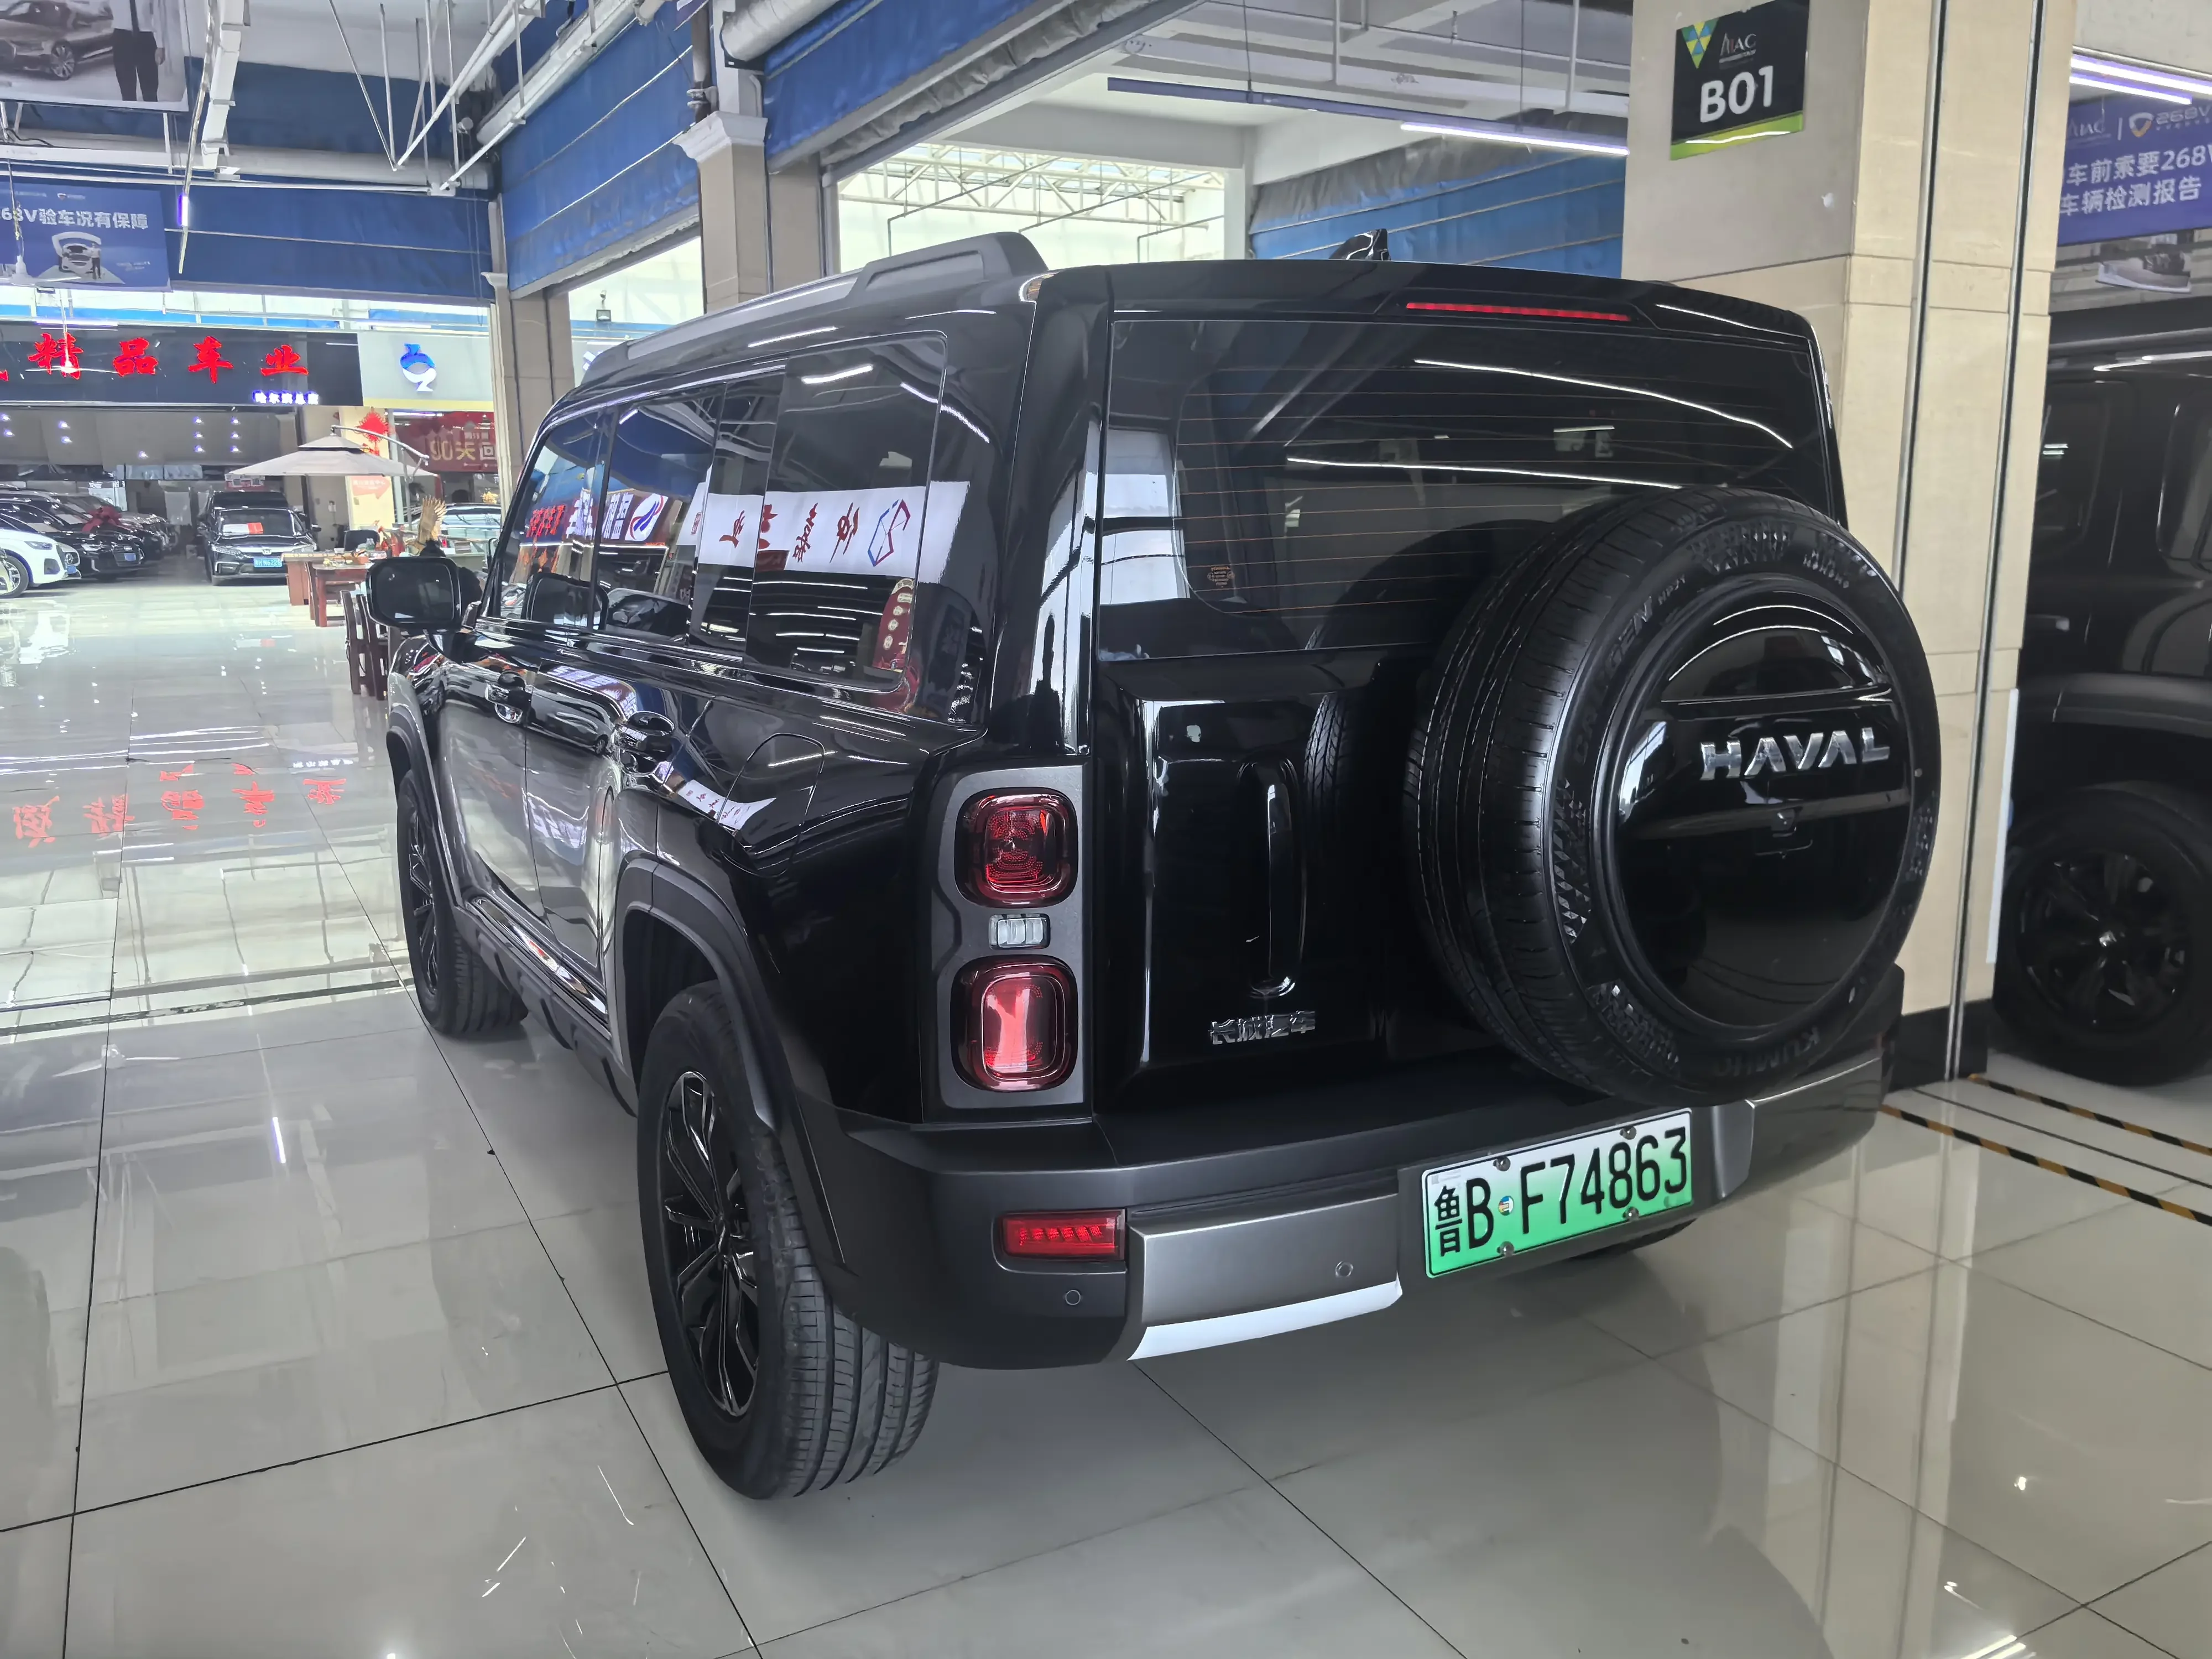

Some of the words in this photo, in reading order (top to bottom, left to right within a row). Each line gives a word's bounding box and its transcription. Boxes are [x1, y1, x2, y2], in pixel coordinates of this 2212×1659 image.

[1700, 65, 1773, 123] B01
[0, 207, 148, 229] 68V验车况有保障
[2059, 174, 2201, 217] 车辆检测报告
[0, 332, 309, 384] 精品车业
[1700, 727, 1890, 781] HAVAL
[1209, 1010, 1316, 1045] 长城汽车
